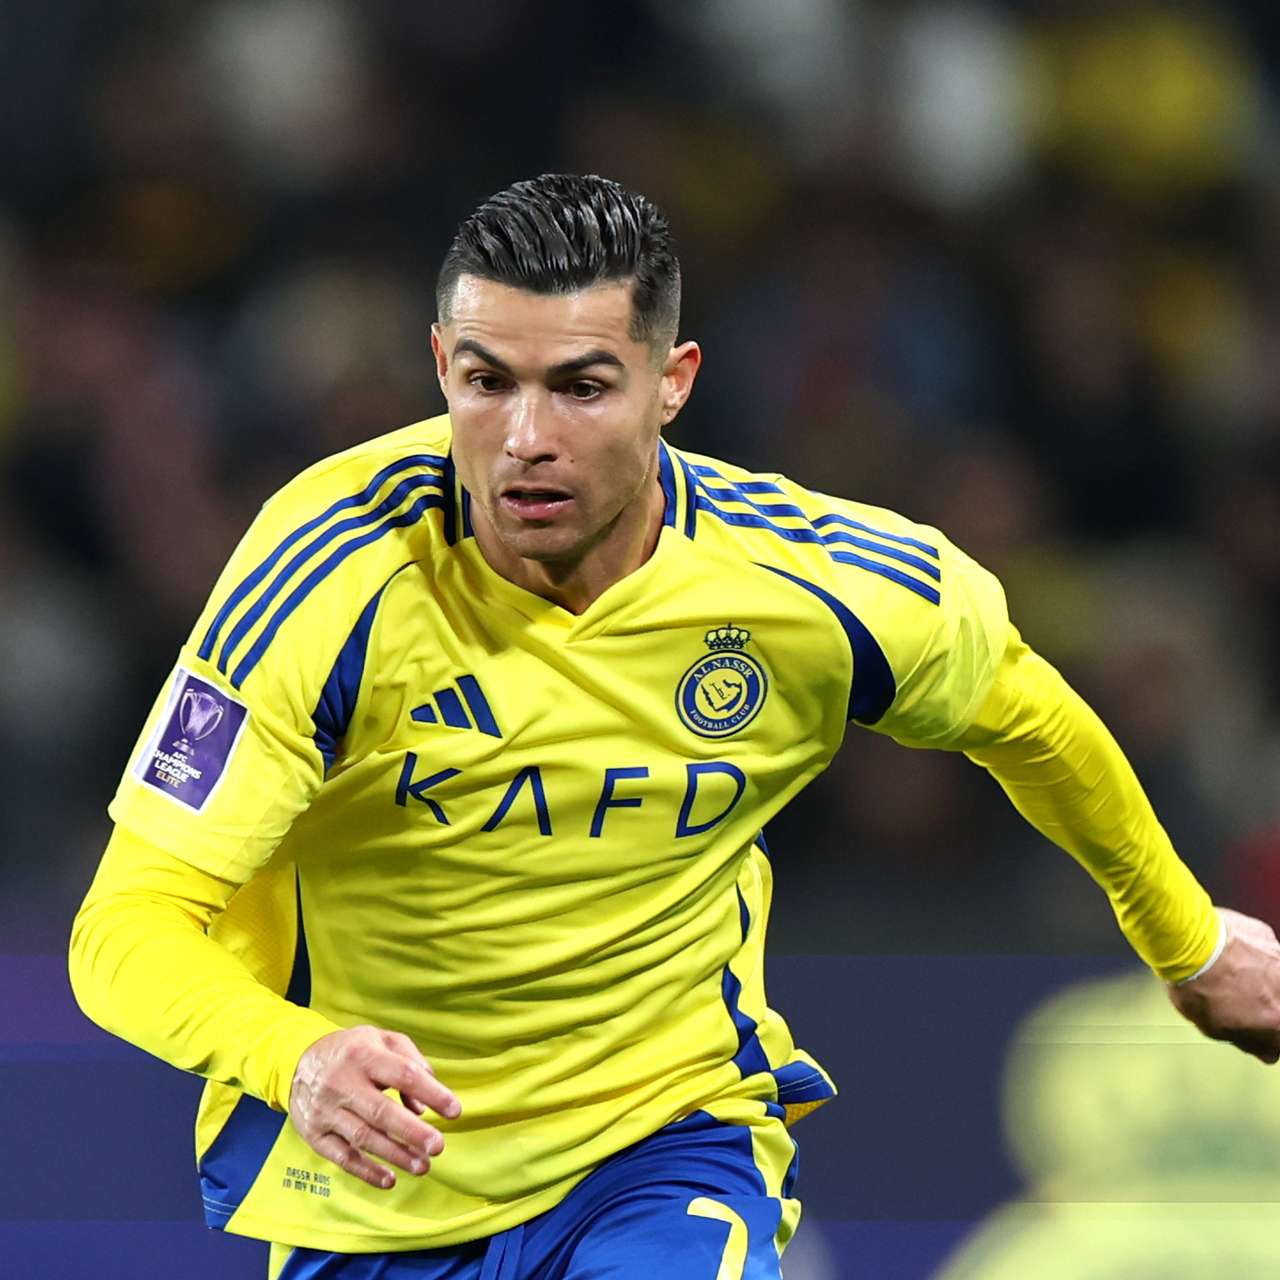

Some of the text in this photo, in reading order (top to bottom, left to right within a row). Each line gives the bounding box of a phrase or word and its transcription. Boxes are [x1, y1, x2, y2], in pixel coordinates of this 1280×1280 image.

[693, 658, 754, 682] AL NASSR
[690, 704, 750, 730] FOOTBALL CLUB
[154, 749, 202, 780] HAMPIONS
[172, 751, 188, 761] AFC
[154, 760, 190, 783] LEAGUE
[155, 770, 182, 788] ELITE
[395, 750, 747, 838] KAFD
